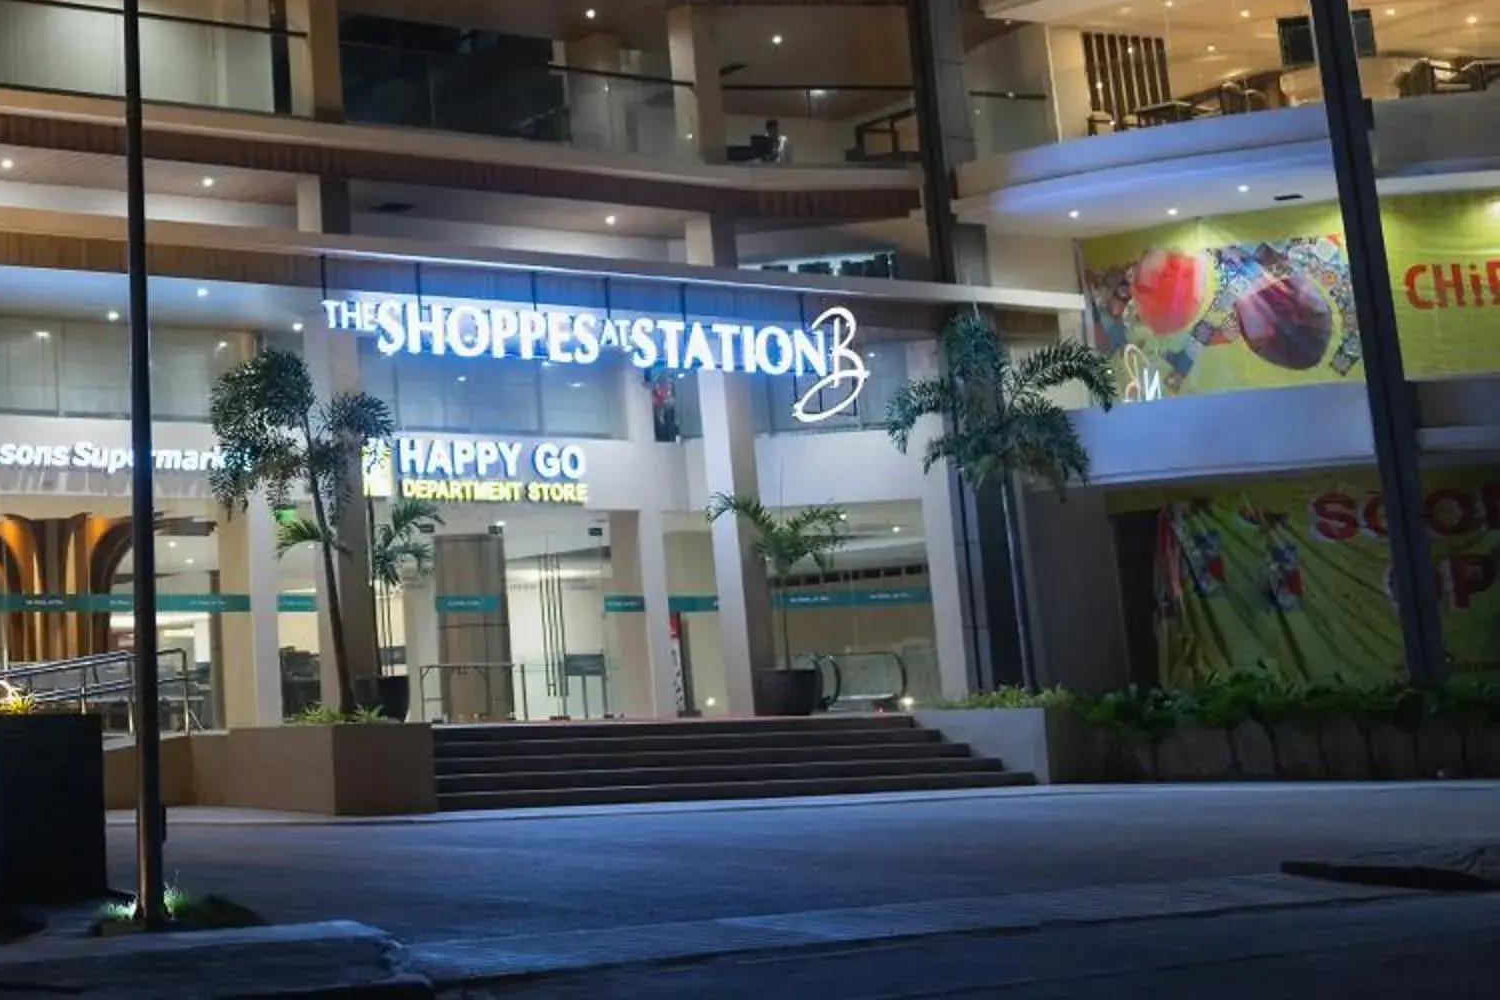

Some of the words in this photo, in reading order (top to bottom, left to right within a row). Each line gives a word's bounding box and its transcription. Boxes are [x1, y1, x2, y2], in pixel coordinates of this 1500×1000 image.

[322, 299, 377, 331] THE
[376, 299, 599, 364] SHOPPES
[631, 317, 828, 377] STATION
[71, 440, 252, 474] Supmark
[399, 438, 522, 478] HAPPY
[534, 442, 586, 480] GO
[401, 479, 523, 502] DEPARTMENT
[527, 481, 588, 503] STORE
